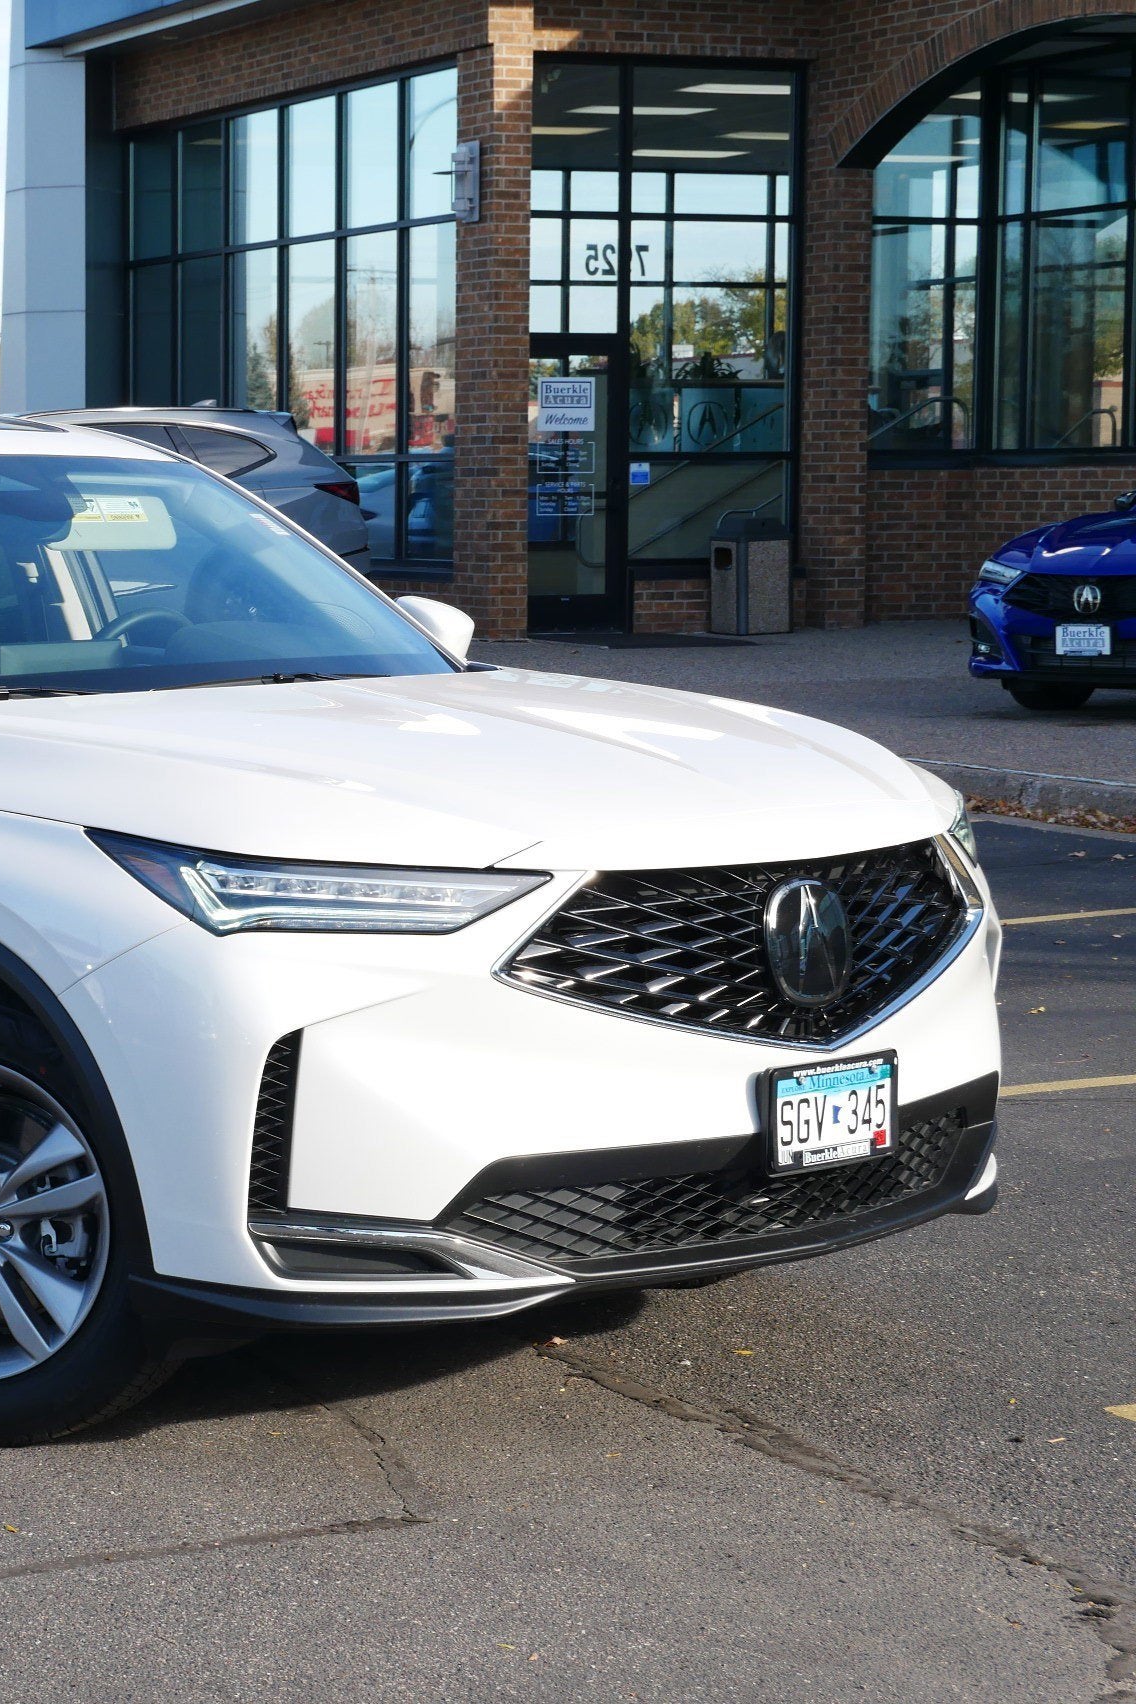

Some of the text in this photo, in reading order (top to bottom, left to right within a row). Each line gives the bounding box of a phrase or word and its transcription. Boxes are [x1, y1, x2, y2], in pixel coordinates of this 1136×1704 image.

[545, 384, 589, 394] Buerkle
[546, 395, 587, 404] Acura
[545, 413, 589, 425] Welcome
[1062, 628, 1105, 637] Buerkle
[1064, 638, 1104, 647] Acura
[780, 1083, 886, 1147] SGV 345
